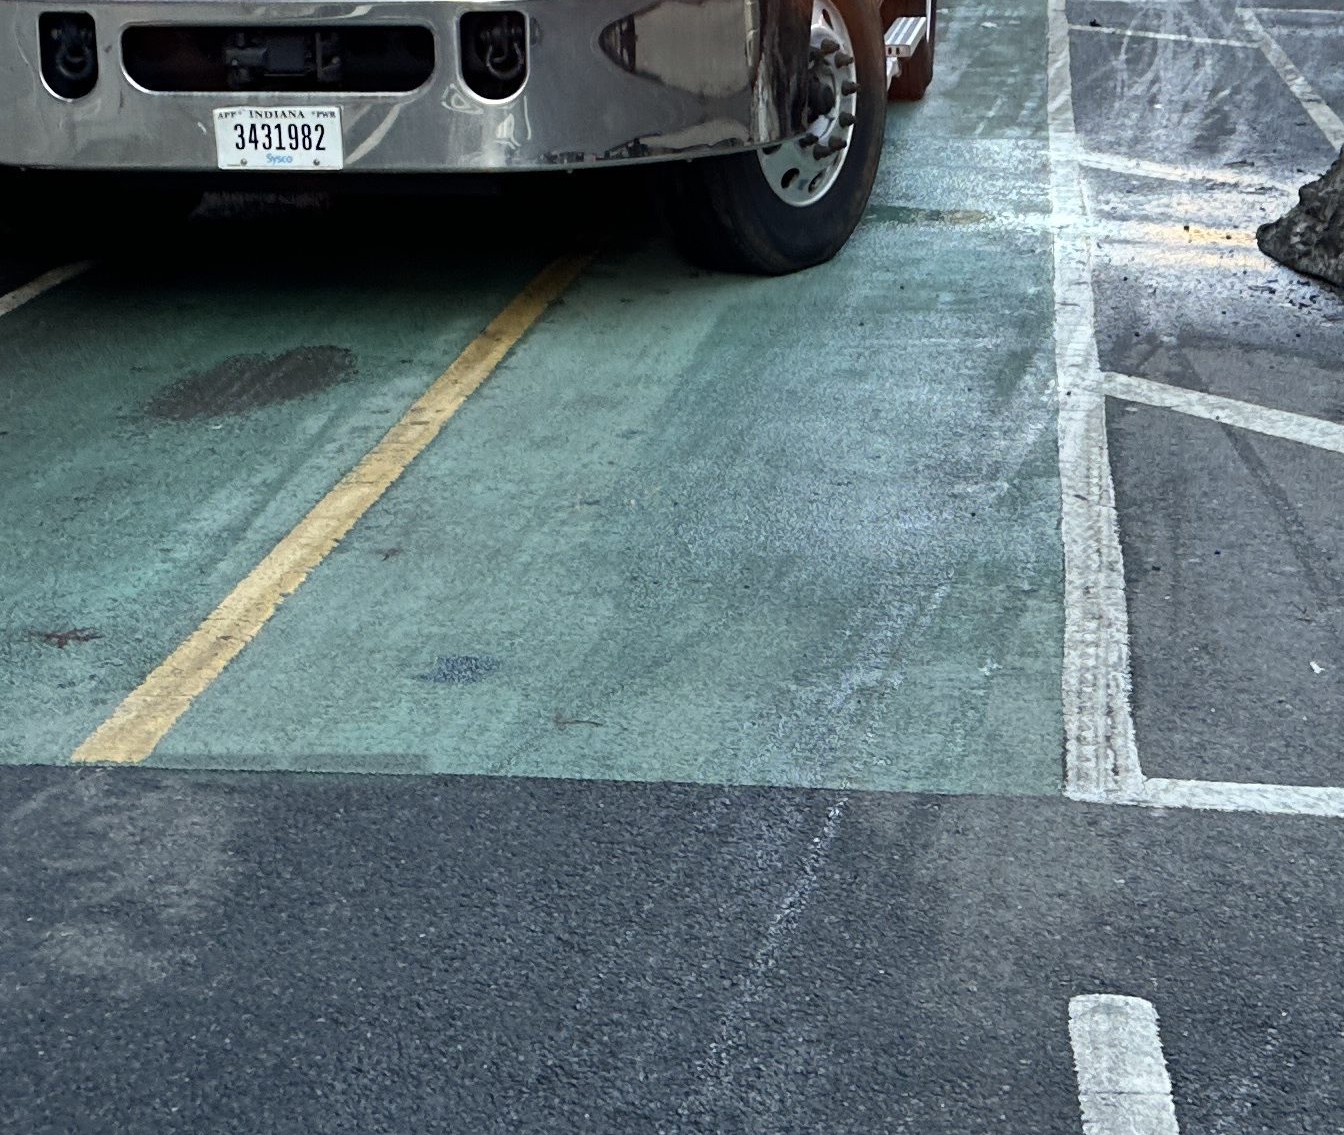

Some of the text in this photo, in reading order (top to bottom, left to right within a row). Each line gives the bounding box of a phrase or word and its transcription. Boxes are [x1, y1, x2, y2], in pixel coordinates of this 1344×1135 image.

[249, 110, 305, 119] INDIANA
[233, 123, 327, 151] 3431982
[265, 152, 294, 165] Sysco
